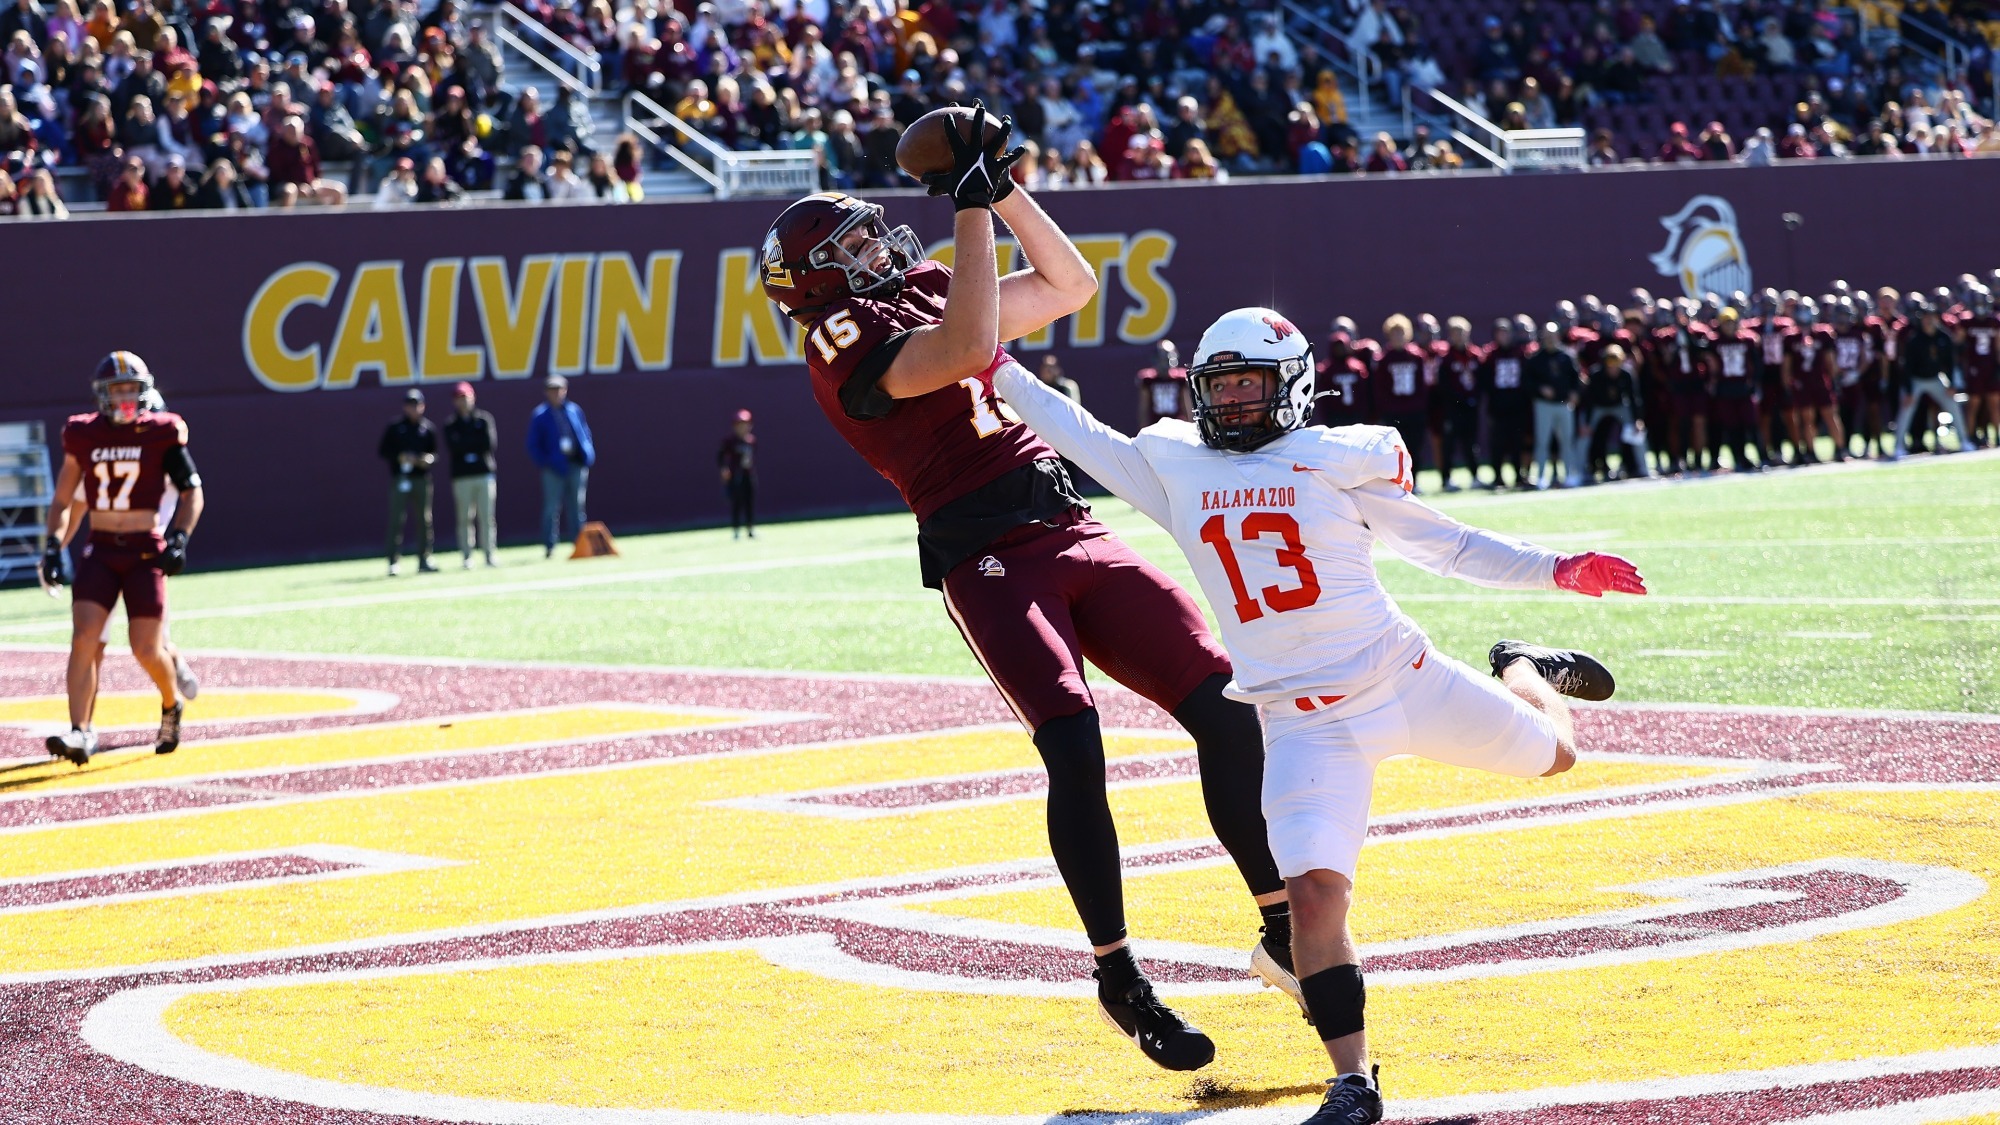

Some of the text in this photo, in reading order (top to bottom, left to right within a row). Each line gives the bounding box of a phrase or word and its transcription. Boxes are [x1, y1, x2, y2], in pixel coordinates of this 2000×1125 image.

[242, 249, 683, 392] CALVIN
[811, 307, 861, 365] 15
[958, 376, 1022, 439] 1
[91, 446, 142, 463] CALVIN
[94, 461, 140, 511] 17
[1201, 486, 1296, 510] KALAMAZOO
[1200, 512, 1321, 624] 13
